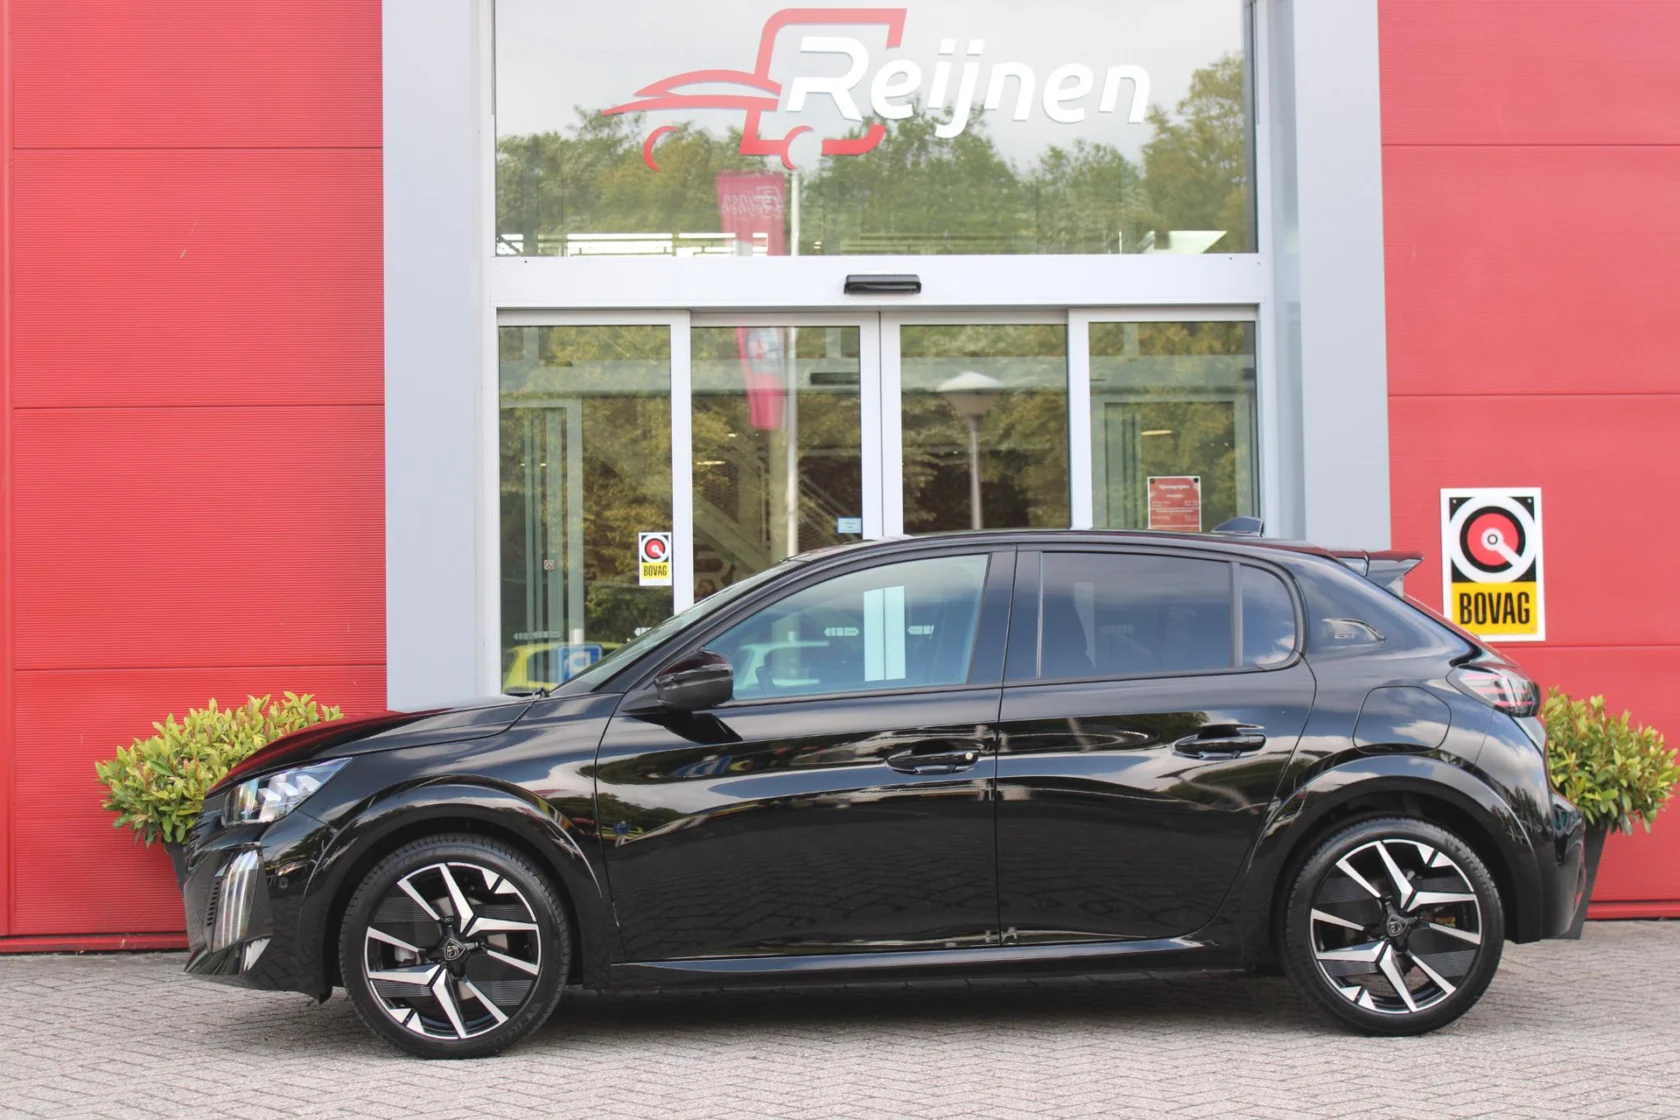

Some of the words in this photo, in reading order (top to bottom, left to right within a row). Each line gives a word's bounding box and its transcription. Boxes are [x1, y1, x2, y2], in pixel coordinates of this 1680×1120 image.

[786, 36, 1150, 138] Reijnen
[643, 565, 668, 577] BOVAG
[1459, 592, 1530, 625] BOVAG
